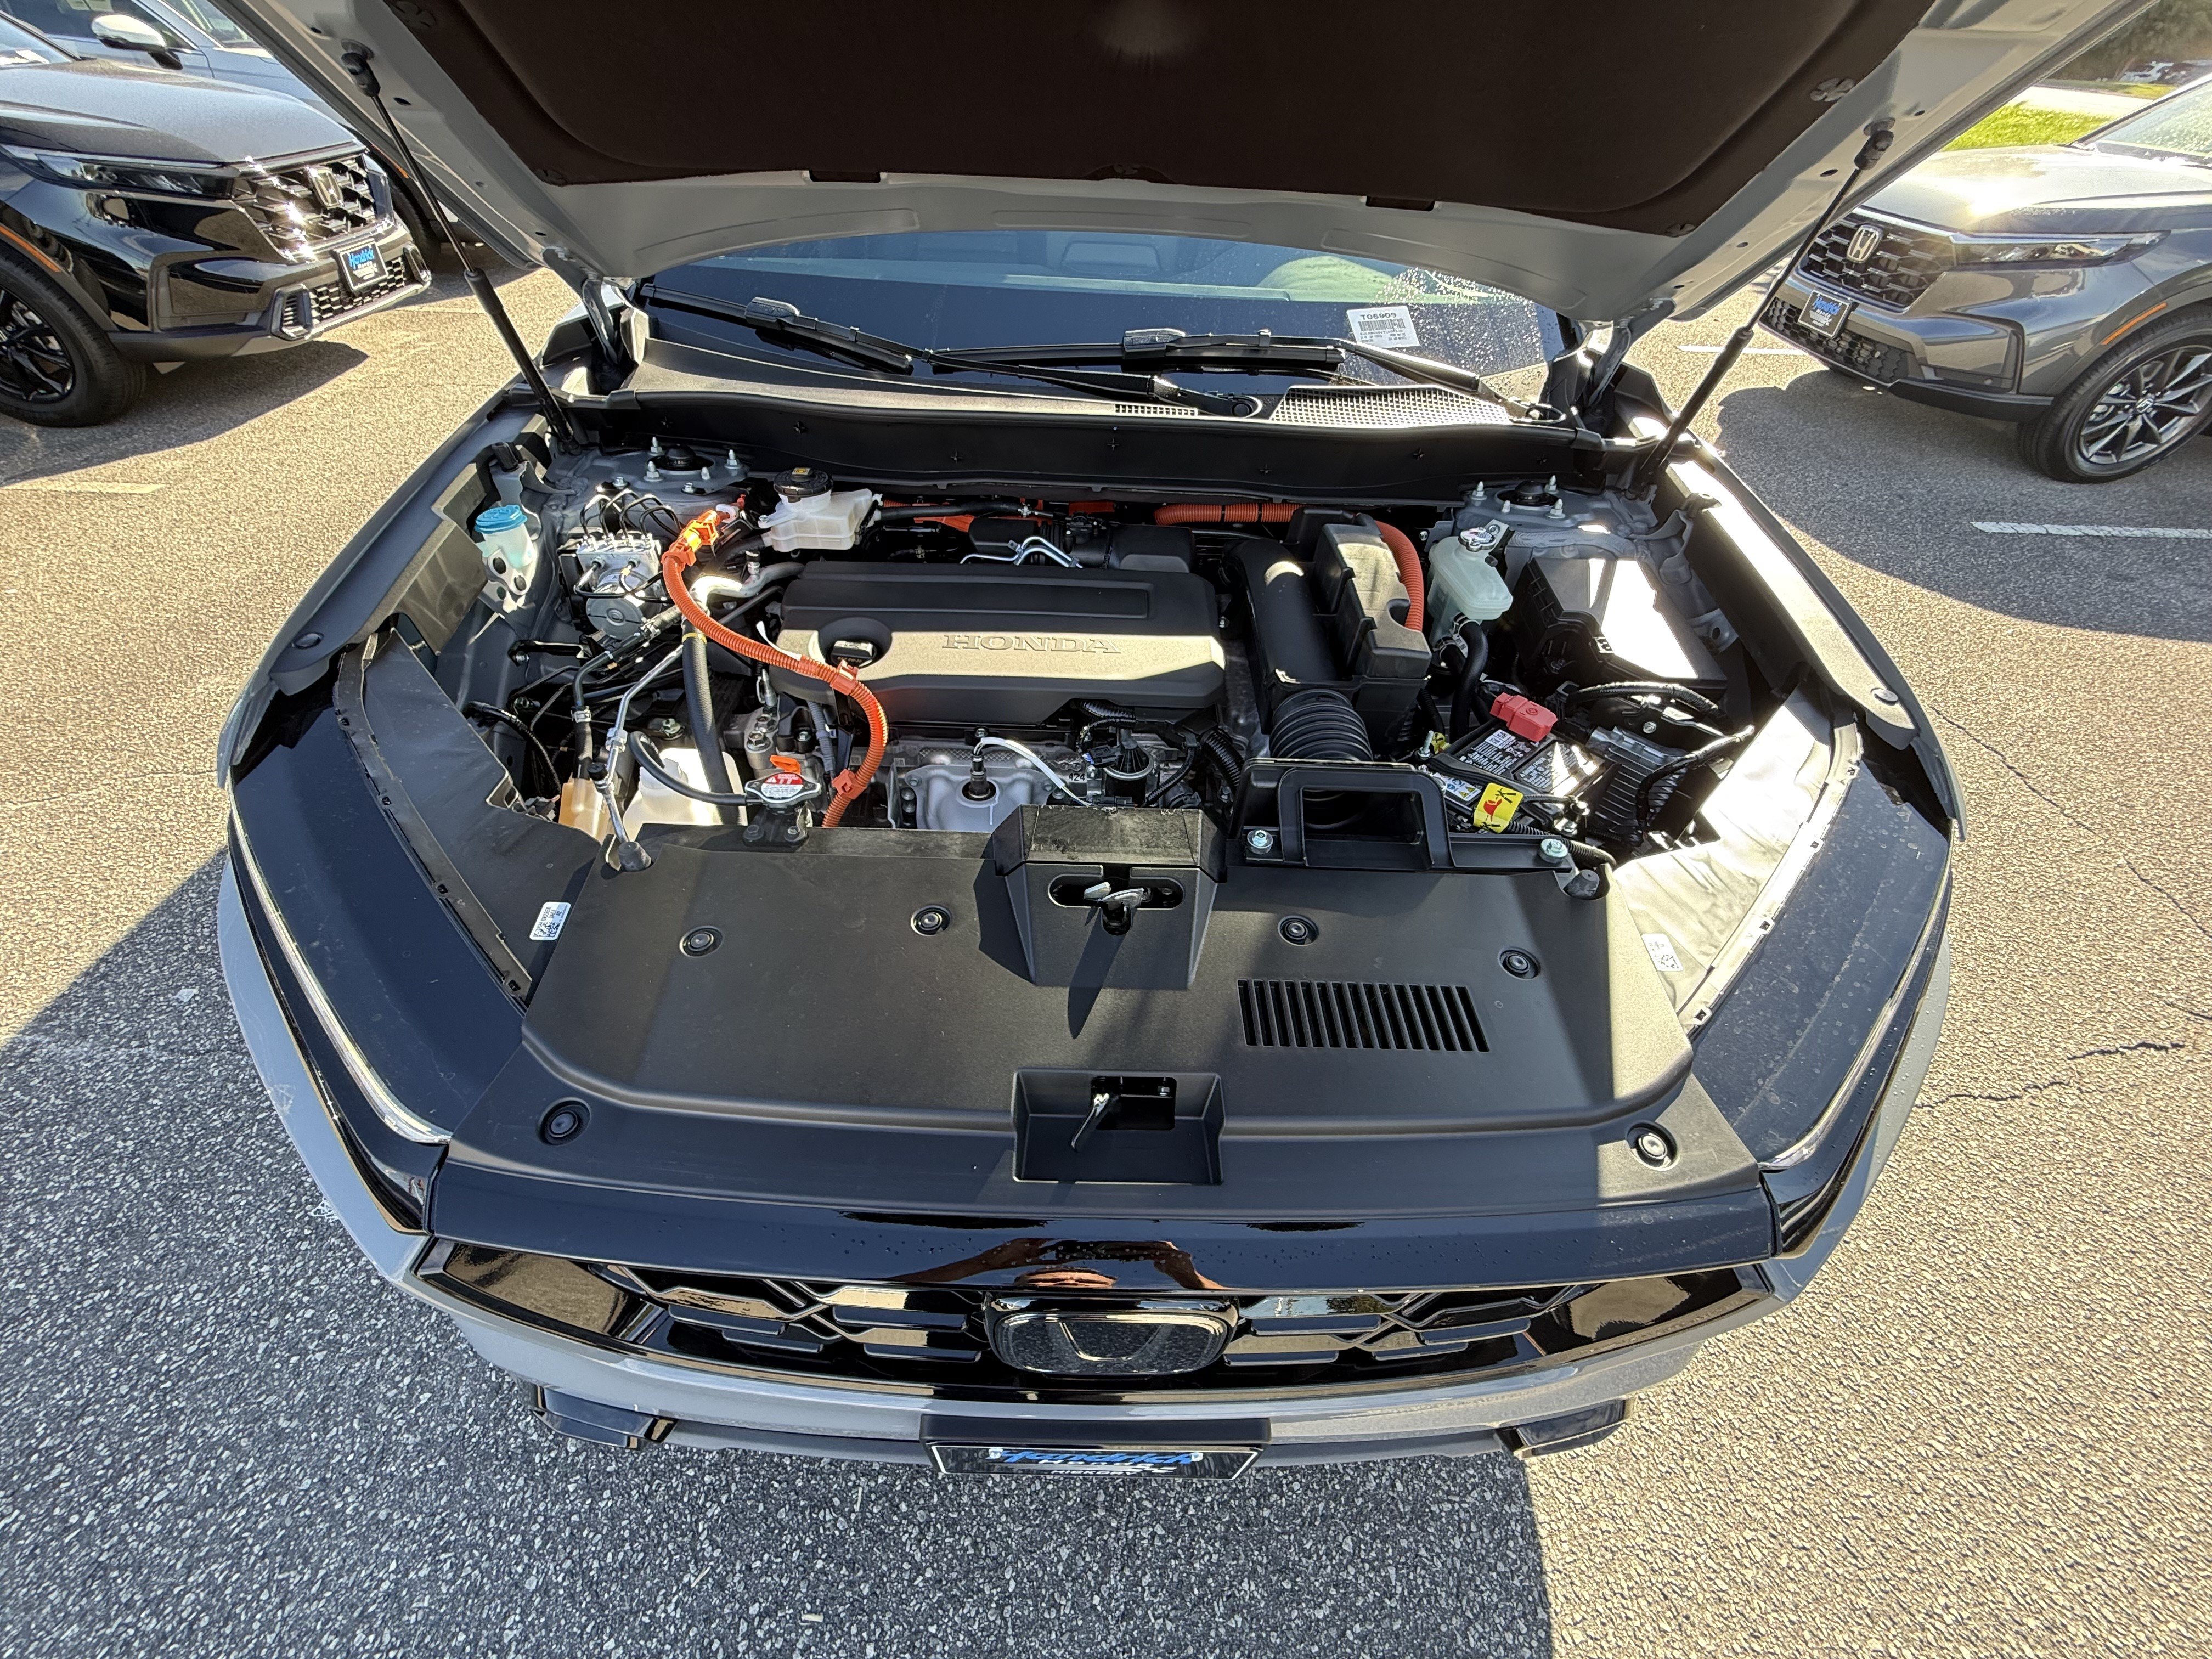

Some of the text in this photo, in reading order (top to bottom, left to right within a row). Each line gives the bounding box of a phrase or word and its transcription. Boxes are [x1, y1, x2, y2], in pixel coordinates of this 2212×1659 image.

[349, 248, 375, 269] Hendrick
[1812, 296, 1841, 315] Hendrick
[942, 634, 1121, 654] HONDA
[1068, 772, 1085, 781] 424
[986, 1450, 1195, 1464] Hendrick
